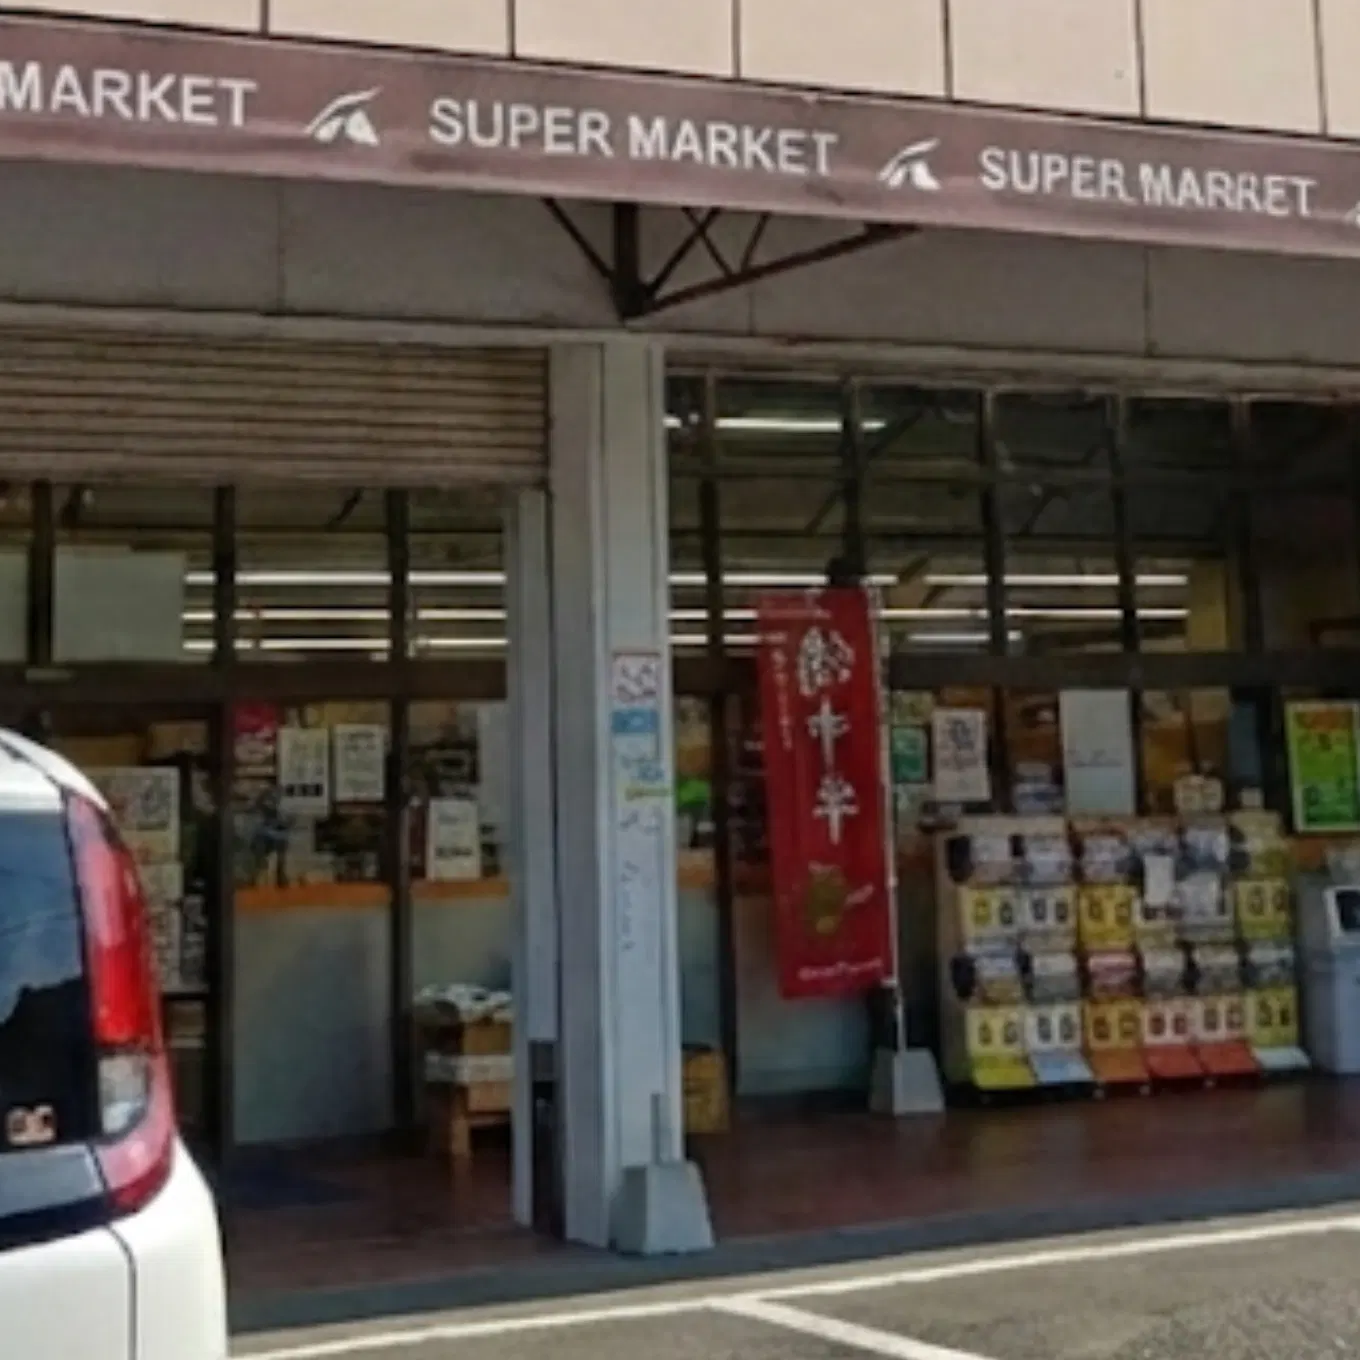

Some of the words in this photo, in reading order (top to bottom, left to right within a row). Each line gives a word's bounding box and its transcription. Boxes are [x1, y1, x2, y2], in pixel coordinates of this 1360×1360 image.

[429, 98, 614, 158] SUPER
[628, 115, 838, 175] MARKET
[979, 146, 1135, 201] SUPER
[1140, 163, 1317, 217] MARKET
